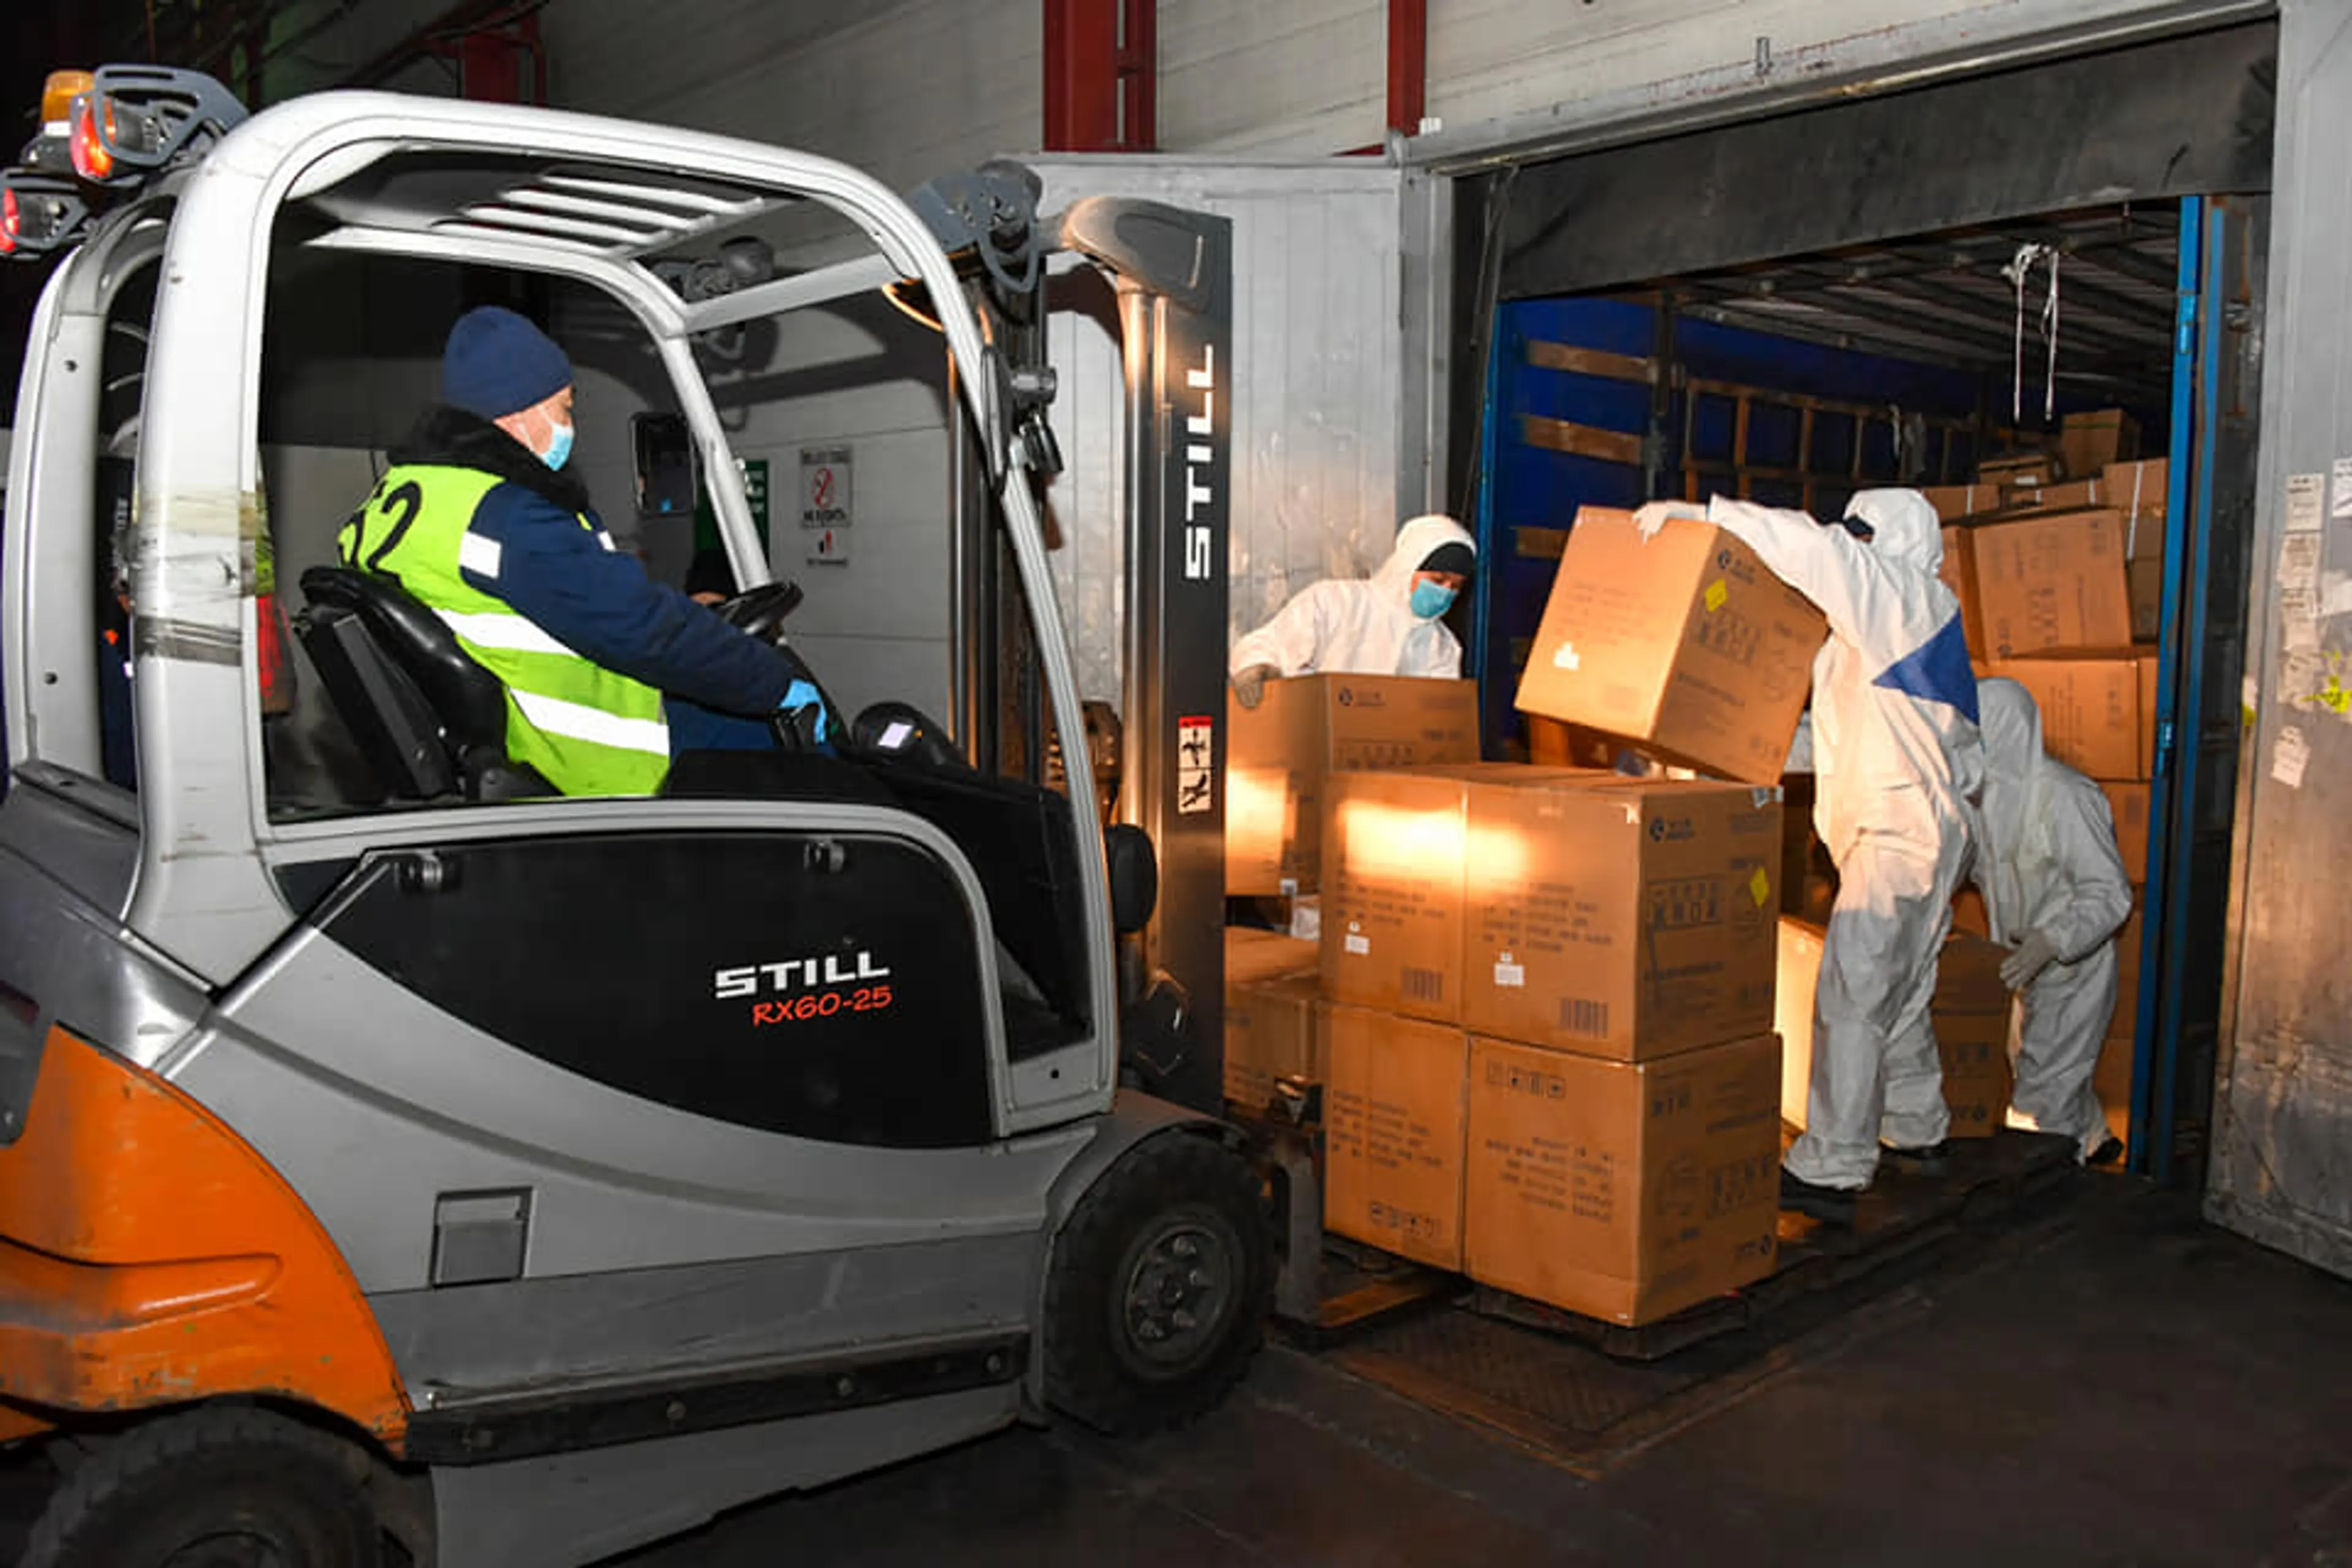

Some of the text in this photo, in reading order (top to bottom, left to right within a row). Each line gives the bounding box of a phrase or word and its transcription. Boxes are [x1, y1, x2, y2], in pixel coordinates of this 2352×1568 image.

[1185, 345, 1213, 579] STILL
[715, 951, 890, 999] STILL
[752, 985, 893, 1027] RX60-25
